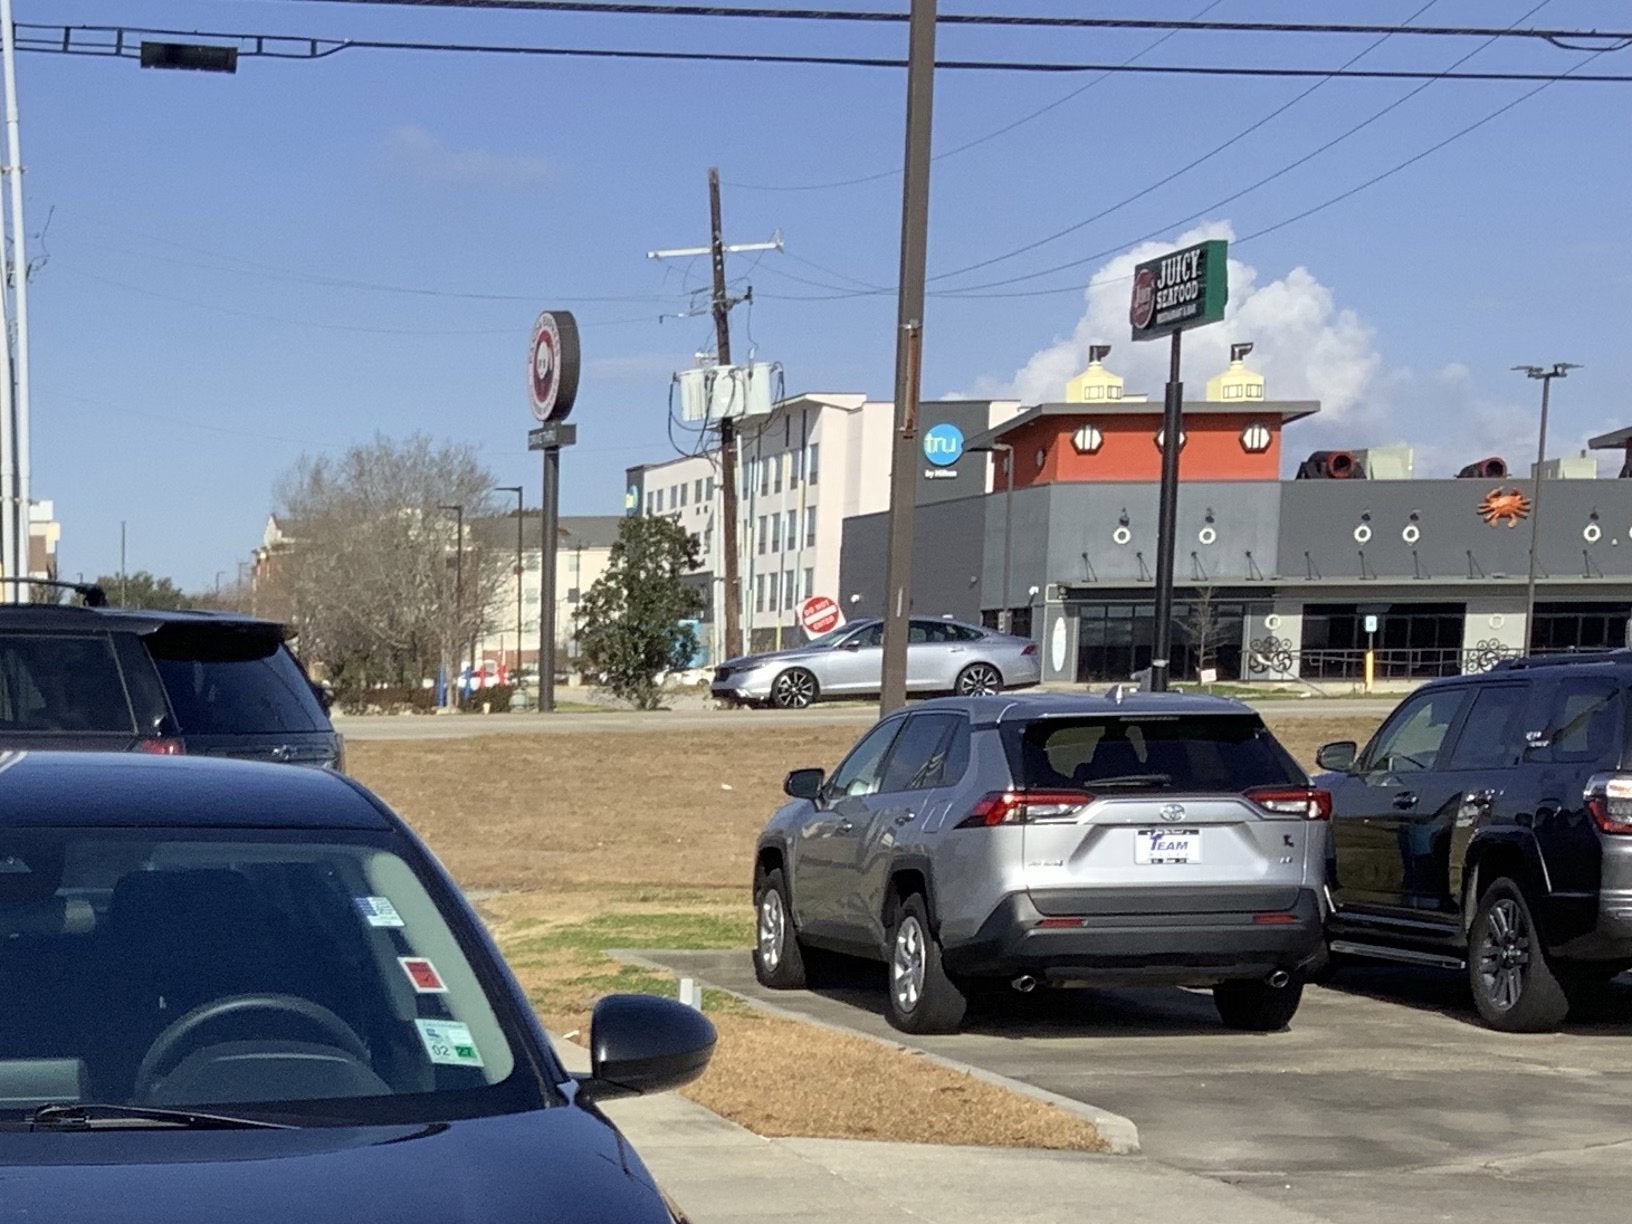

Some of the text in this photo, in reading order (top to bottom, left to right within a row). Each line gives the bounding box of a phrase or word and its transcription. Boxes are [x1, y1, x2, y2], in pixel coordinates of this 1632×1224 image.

[1157, 249, 1201, 289] JUICY
[1156, 280, 1199, 310] SEAFOOD
[924, 433, 957, 453] tru
[1149, 831, 1189, 851] TEAM
[432, 1044, 450, 1056] 02
